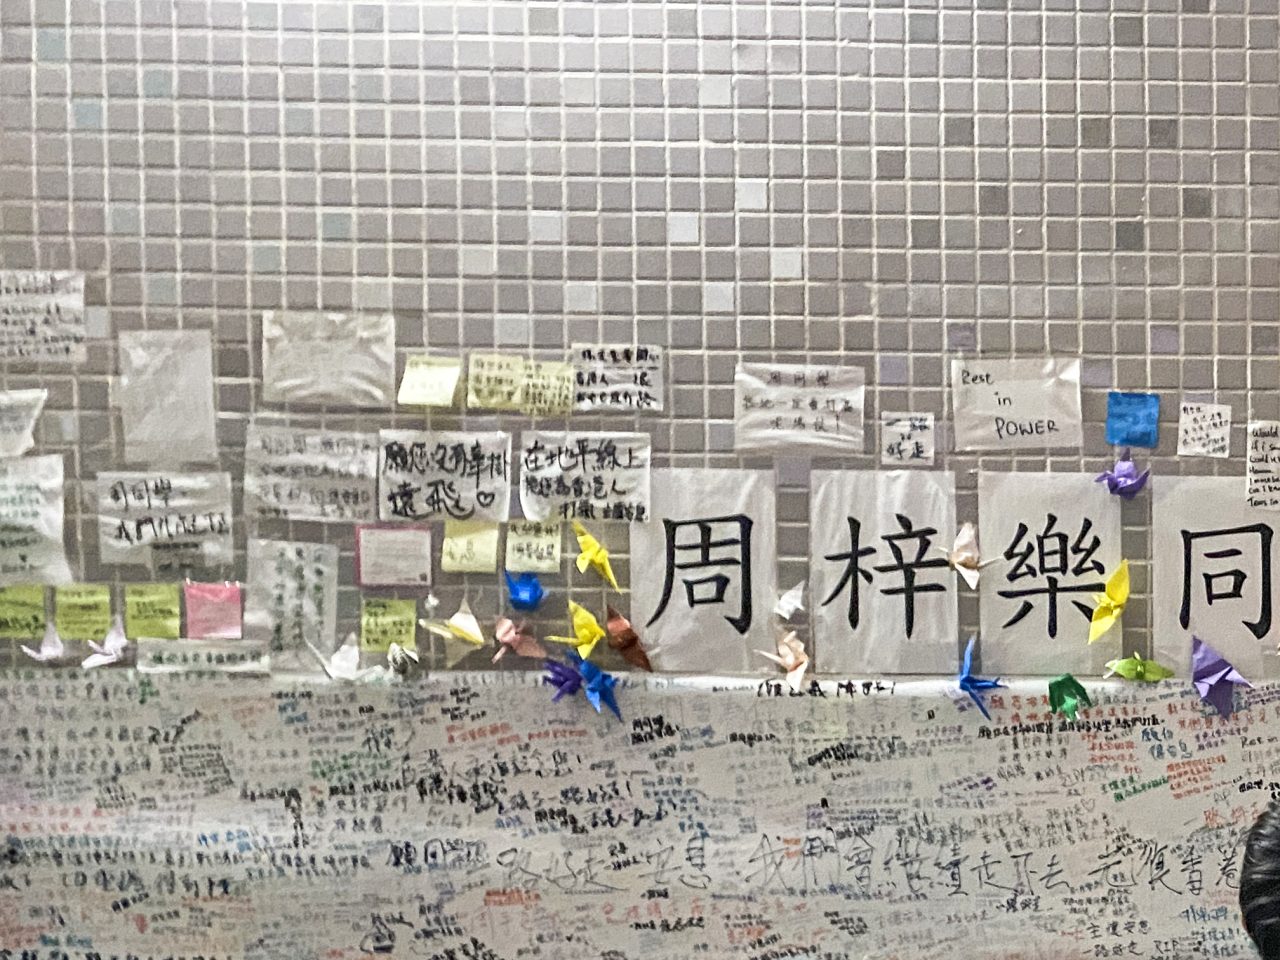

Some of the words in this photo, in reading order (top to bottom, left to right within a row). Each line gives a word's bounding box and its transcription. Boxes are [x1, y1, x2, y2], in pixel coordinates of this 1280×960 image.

[961, 369, 994, 386] Rest
[998, 392, 1012, 407] in
[995, 418, 1060, 438] POWER
